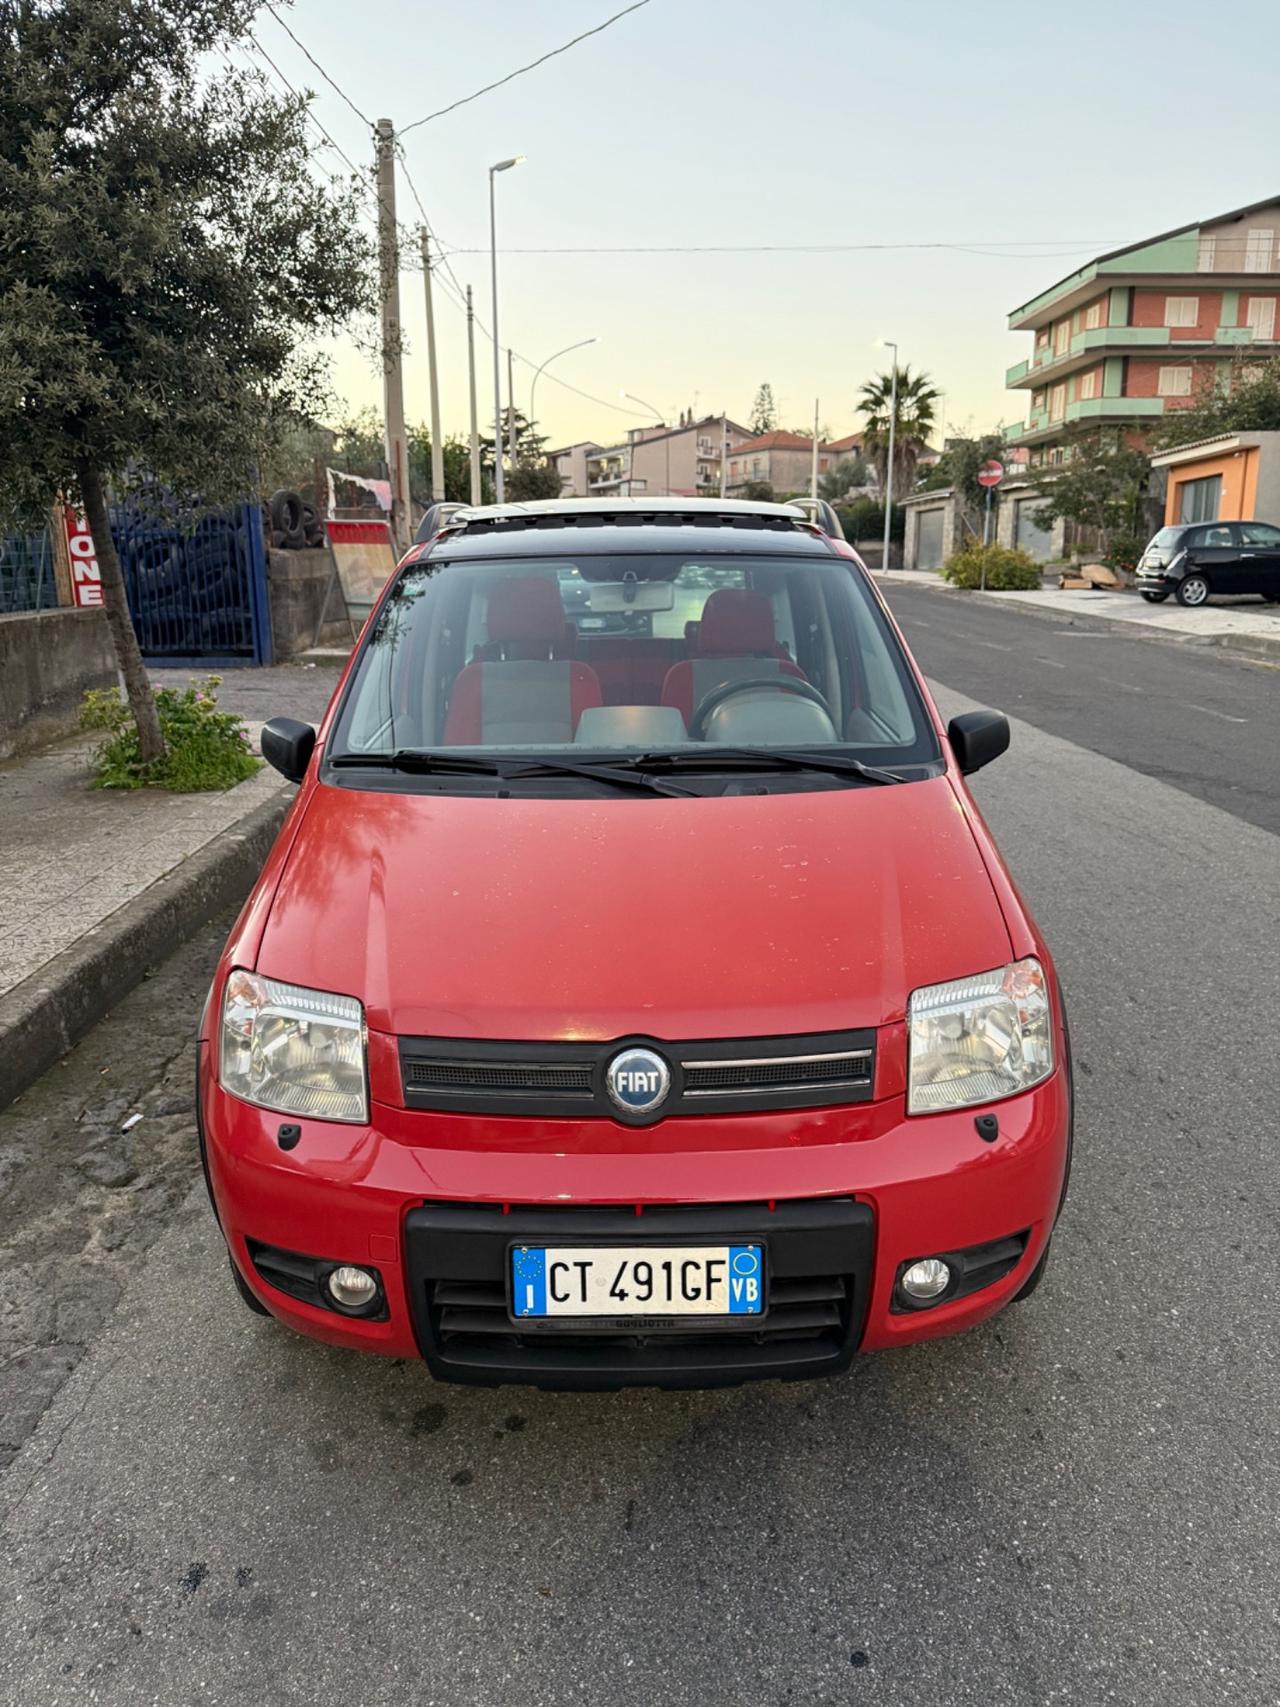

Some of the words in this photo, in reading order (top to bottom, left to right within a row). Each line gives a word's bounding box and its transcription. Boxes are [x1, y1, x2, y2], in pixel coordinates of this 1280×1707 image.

[67, 489, 104, 606] IONE
[617, 1072, 659, 1092] FIAT
[549, 1260, 593, 1302] CT
[609, 1259, 726, 1302] 491GF
[731, 1277, 759, 1302] VB
[526, 1284, 535, 1309] I
